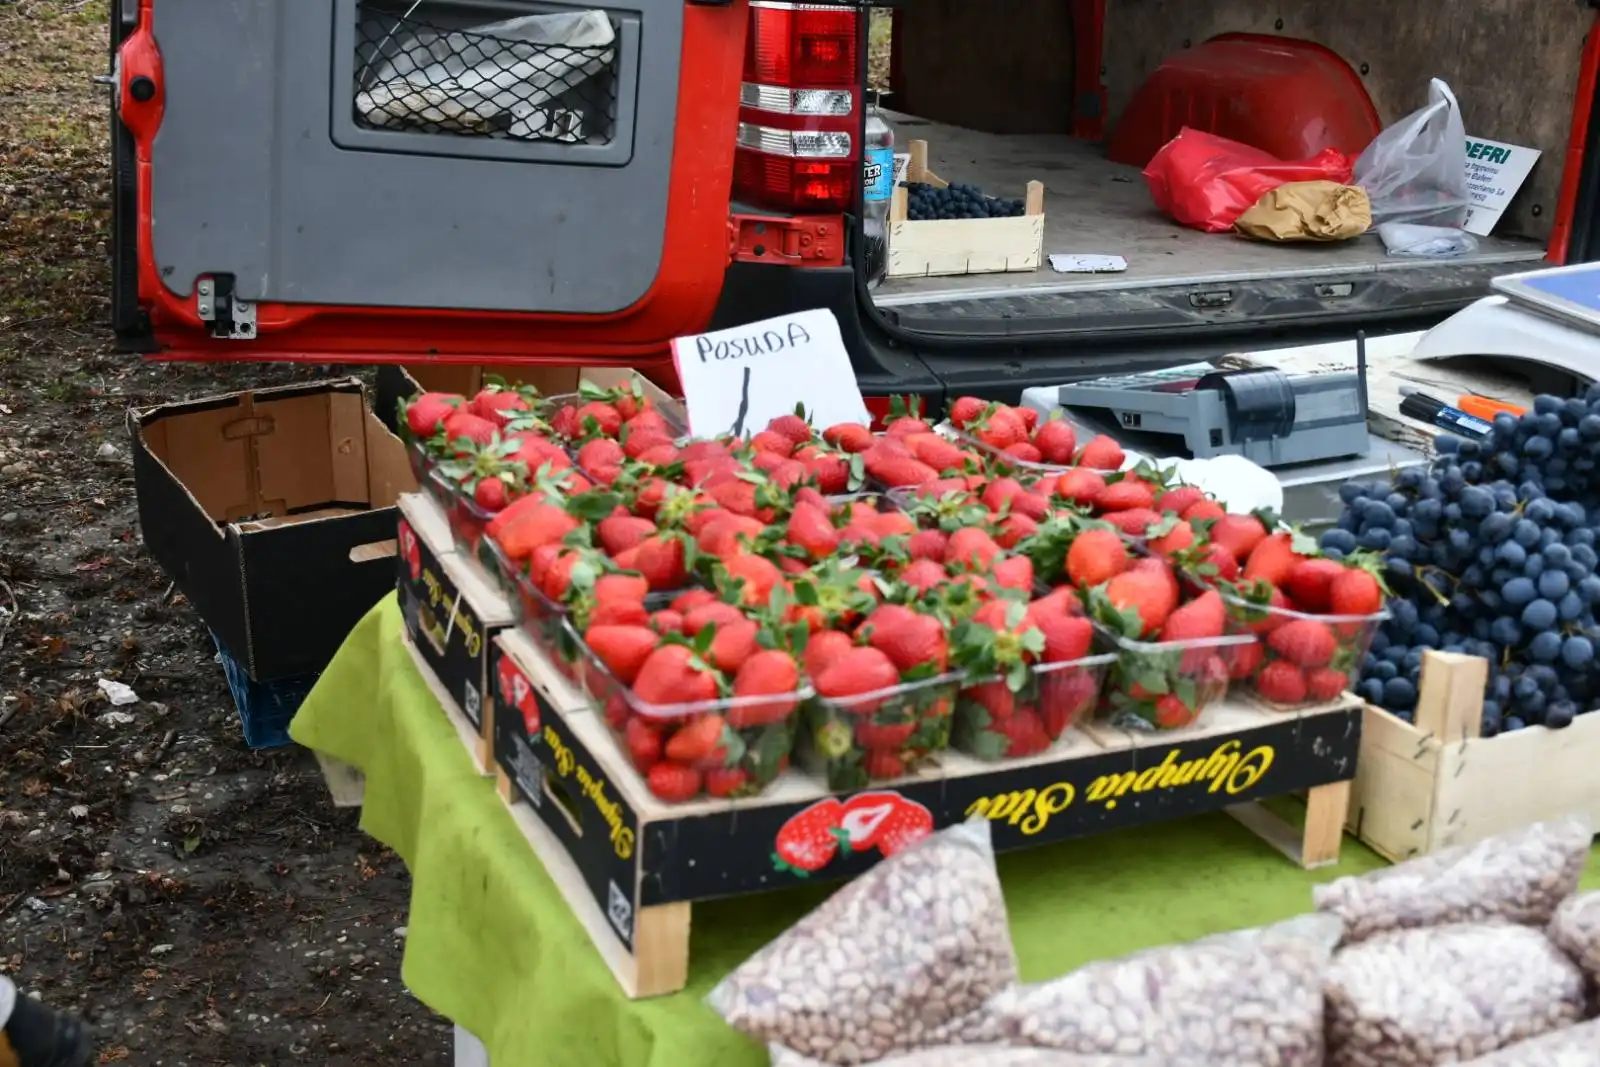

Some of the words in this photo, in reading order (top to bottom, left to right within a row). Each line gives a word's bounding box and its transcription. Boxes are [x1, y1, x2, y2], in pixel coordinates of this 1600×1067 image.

[695, 322, 810, 363] POSUDA
[1085, 739, 1275, 810] Olympia
[963, 781, 1076, 836] Star
